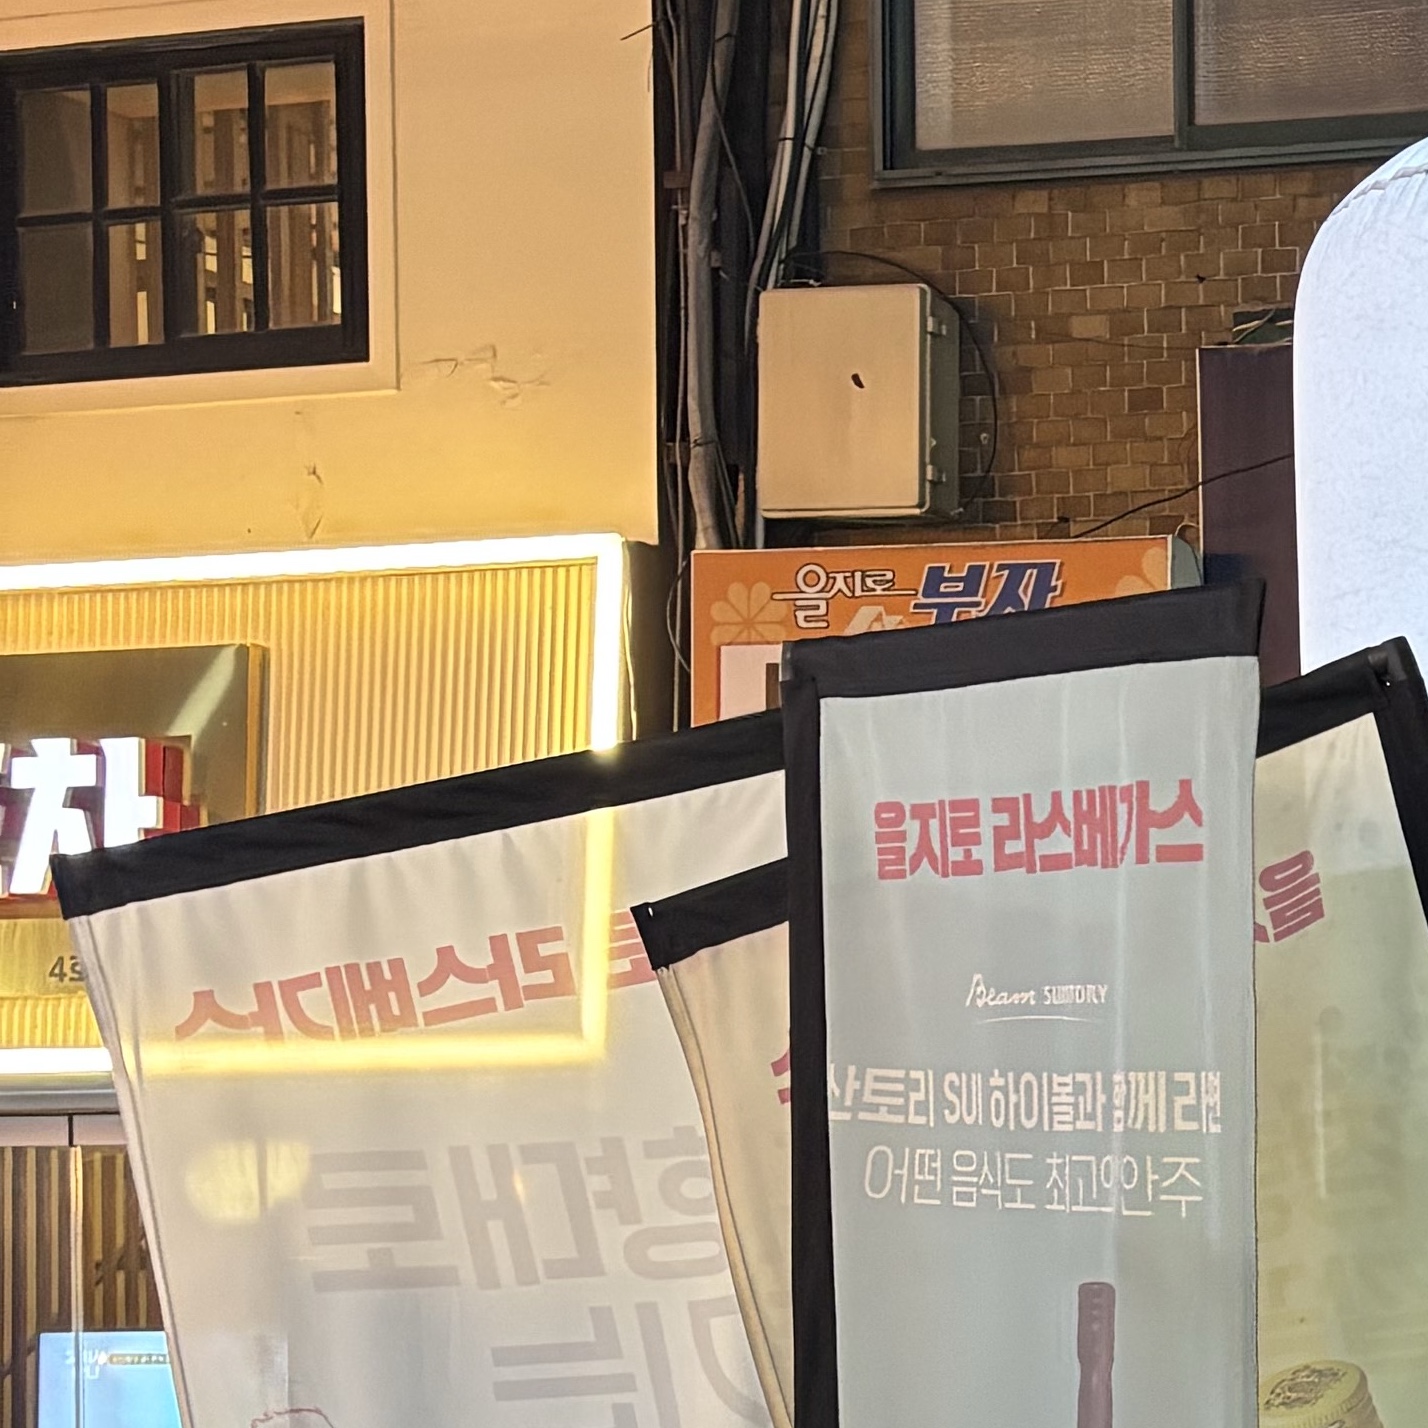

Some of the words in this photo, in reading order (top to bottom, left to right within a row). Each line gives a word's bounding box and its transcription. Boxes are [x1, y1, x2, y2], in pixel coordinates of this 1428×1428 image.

[772, 563, 917, 628] 을지로
[0, 737, 163, 894] 차
[874, 797, 984, 881] 을지로
[991, 779, 1204, 874] 라스베가스
[966, 973, 1036, 1007] Beam
[829, 1063, 934, 1127] 산토리
[943, 1072, 982, 1126] SUI
[989, 1069, 1104, 1133] 하이볼과
[864, 1144, 941, 1206] 어떤
[950, 1152, 1036, 1211] 음식도
